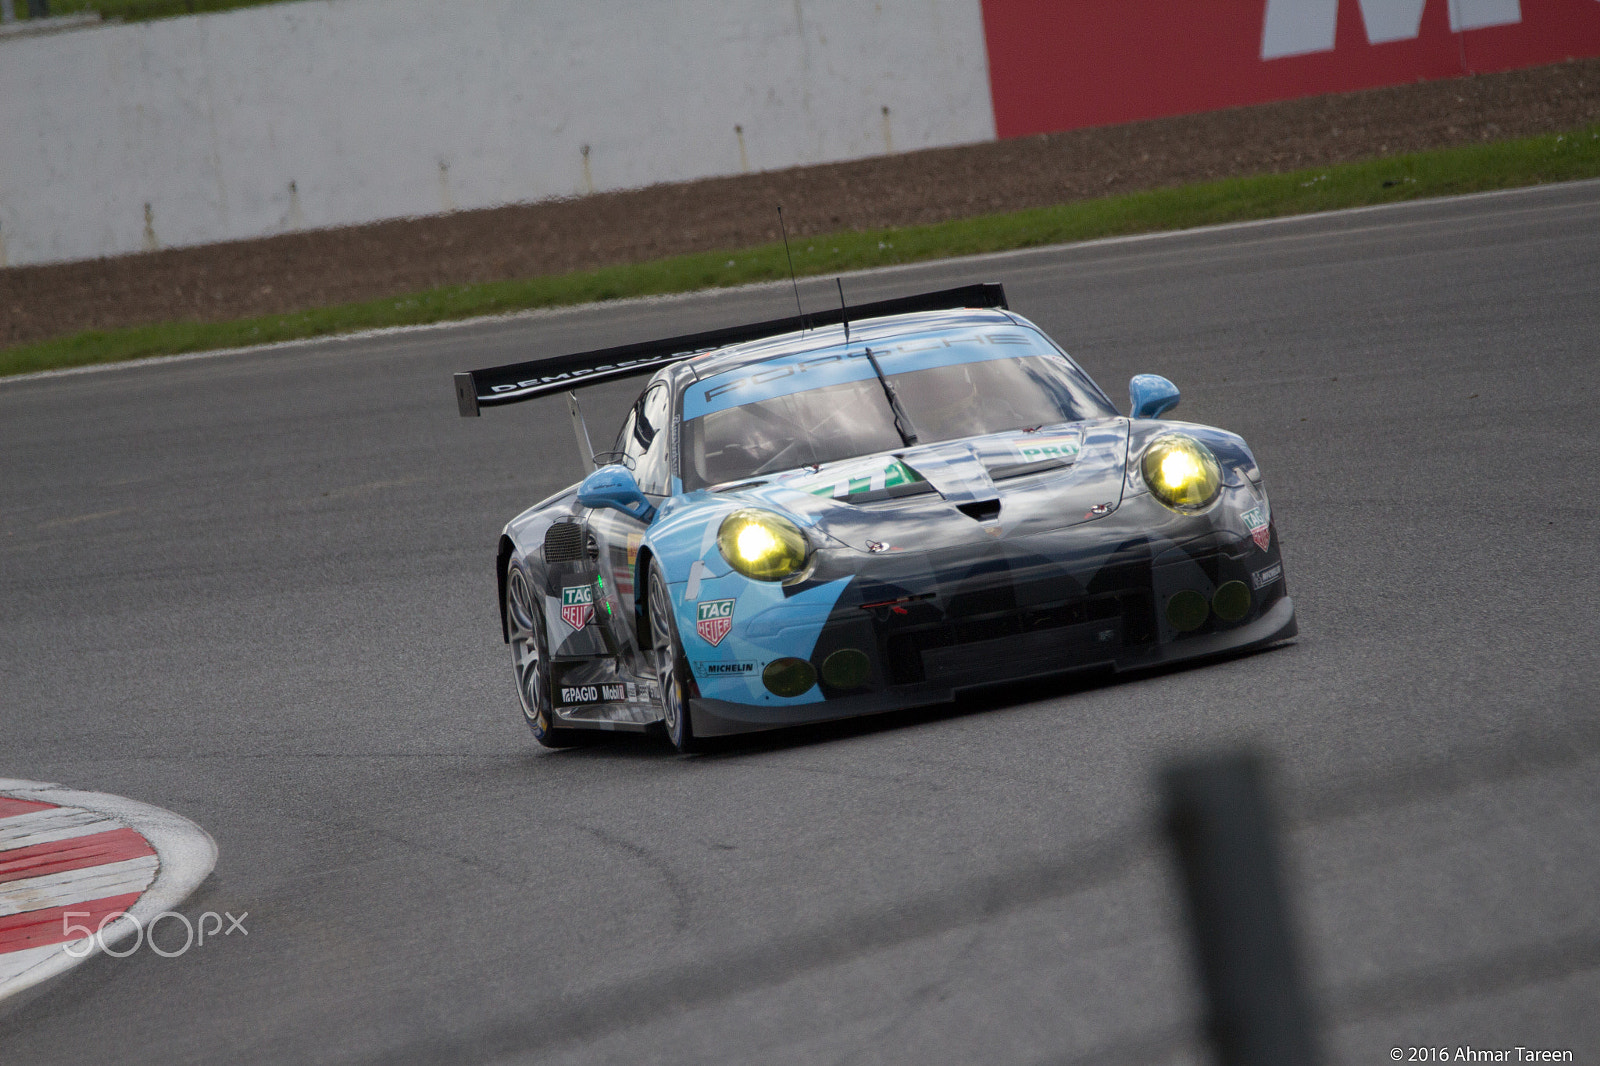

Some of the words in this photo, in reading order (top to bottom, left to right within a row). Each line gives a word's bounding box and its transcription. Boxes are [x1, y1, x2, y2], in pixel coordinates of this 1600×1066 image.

[703, 334, 1032, 403] PORSCHE
[1022, 444, 1080, 461] PRO
[1243, 509, 1265, 527] TAG
[565, 587, 592, 604] TAG
[563, 605, 587, 628] HEU
[700, 601, 731, 619] TAG
[697, 619, 730, 645] HEUER
[708, 663, 754, 673] MICHELIN
[569, 686, 598, 702] PAGID
[602, 684, 620, 700] Mobil
